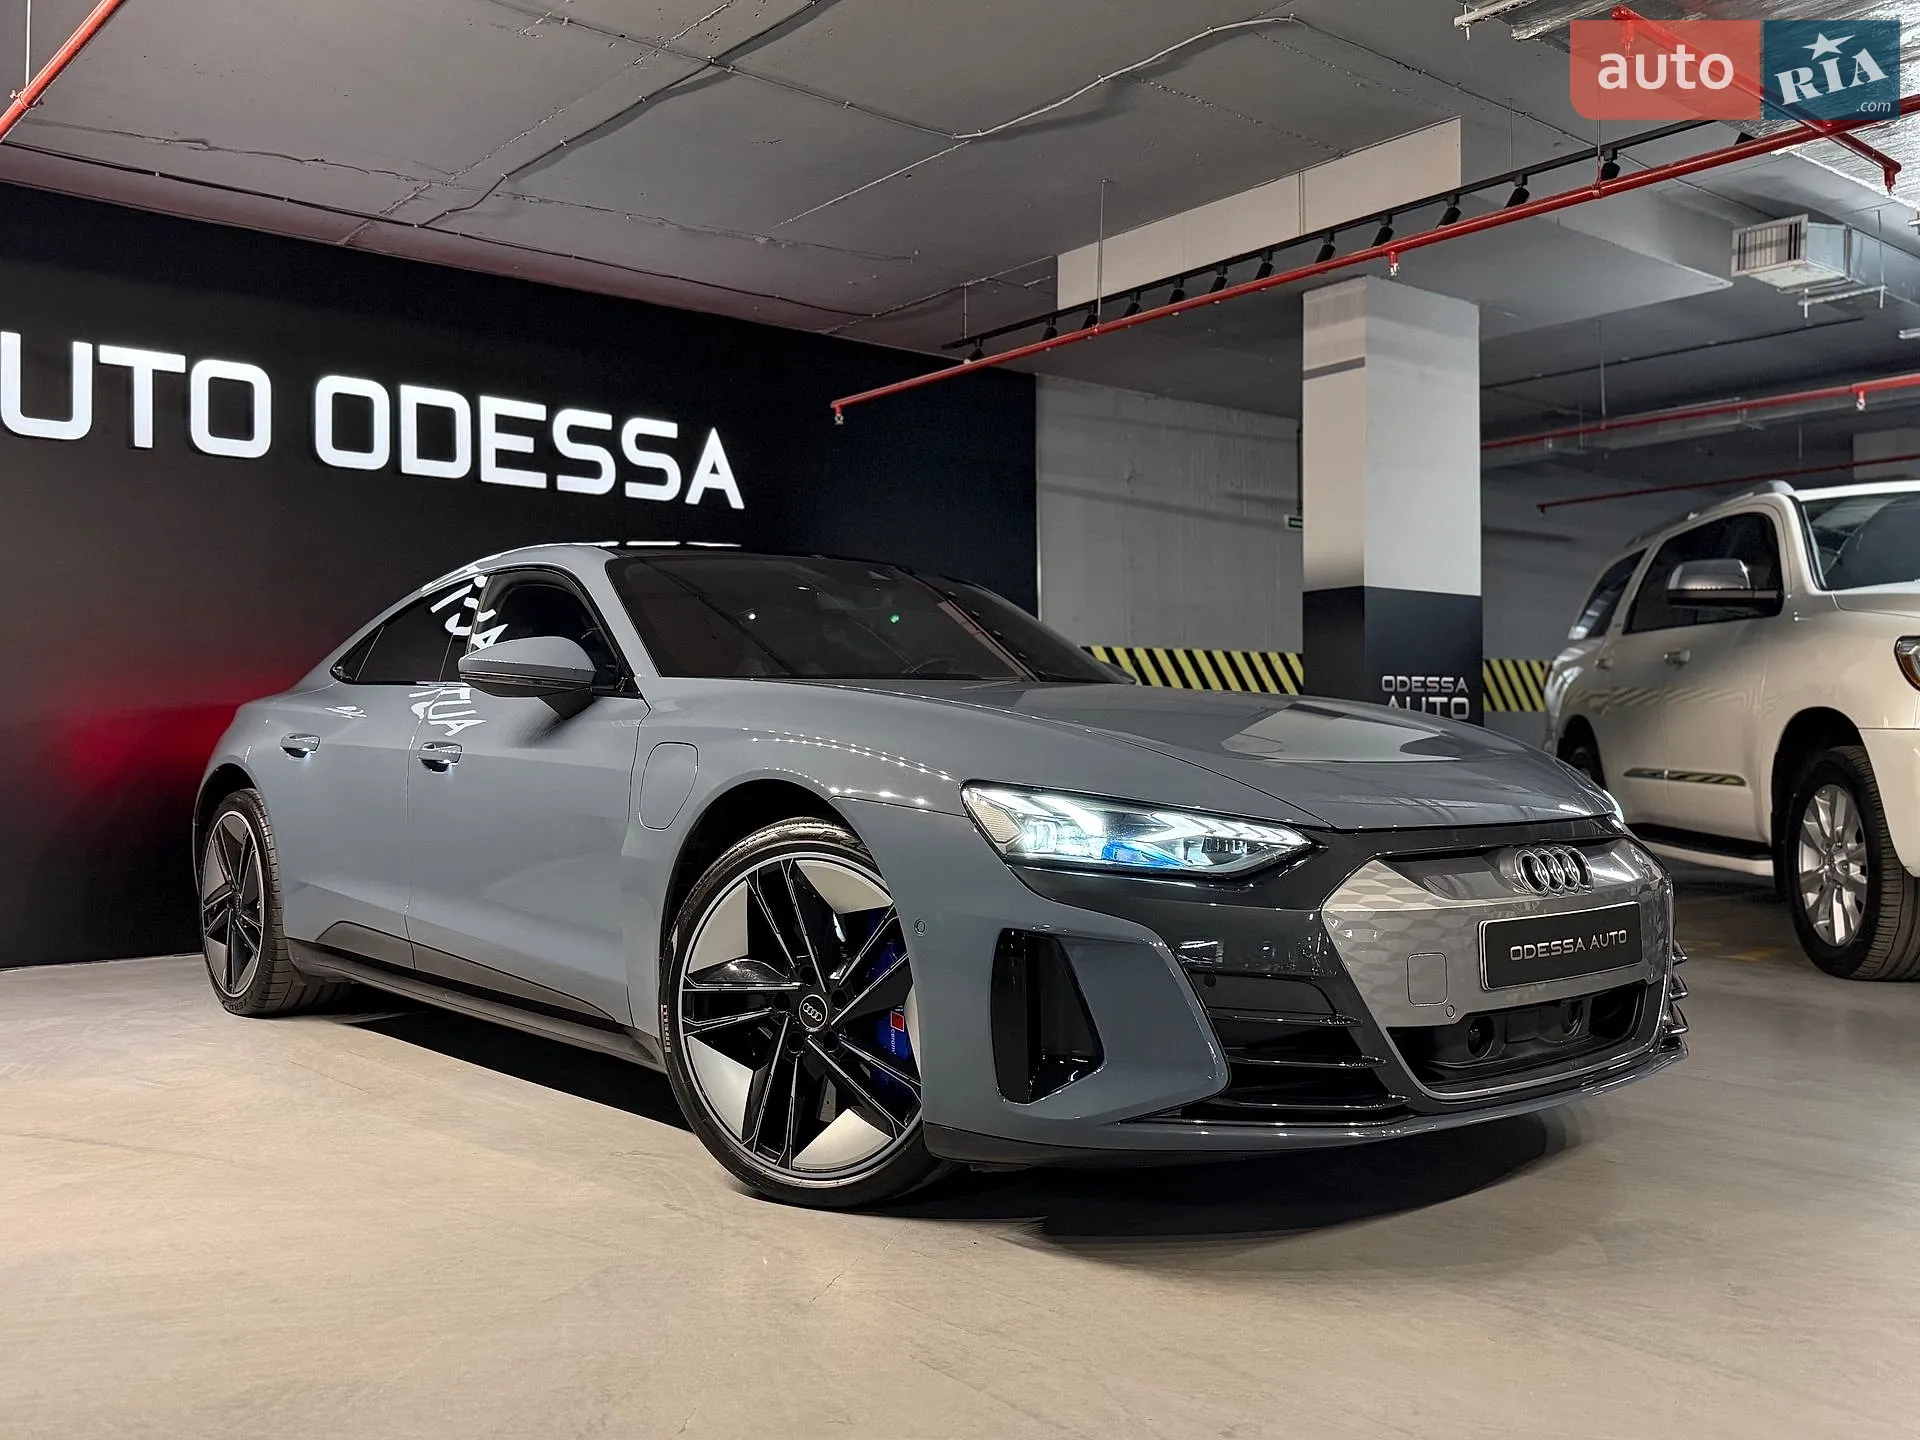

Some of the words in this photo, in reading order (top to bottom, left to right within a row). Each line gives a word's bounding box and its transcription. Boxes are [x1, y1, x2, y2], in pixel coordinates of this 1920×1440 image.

[0, 331, 271, 458] UTO
[315, 375, 744, 509] ODESSA
[1382, 675, 1469, 693] ODESSA
[1510, 937, 1586, 961] ODESSA
[1589, 929, 1628, 950] AUTO
